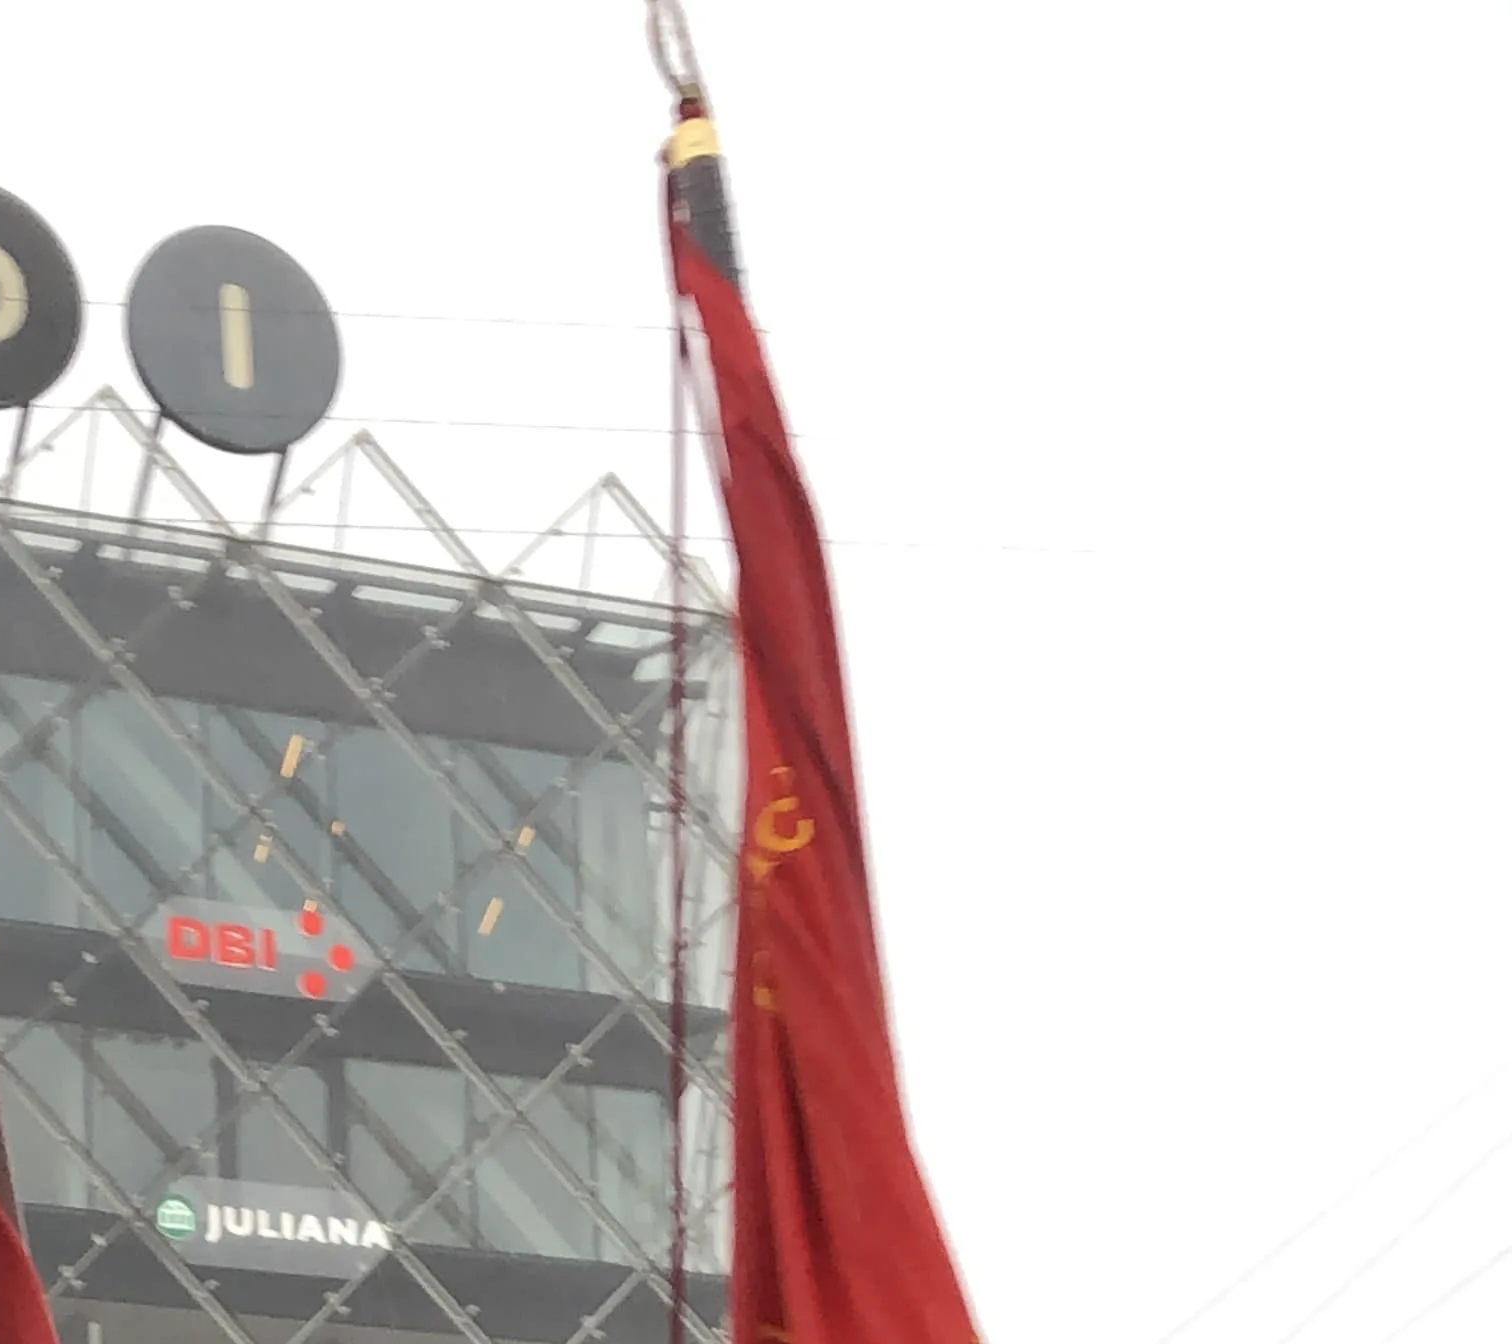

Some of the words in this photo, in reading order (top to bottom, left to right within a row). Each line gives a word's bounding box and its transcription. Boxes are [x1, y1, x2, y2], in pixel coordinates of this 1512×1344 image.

[218, 283, 254, 389] I
[167, 916, 277, 972] DBI
[206, 1203, 391, 1250] JULIANA
